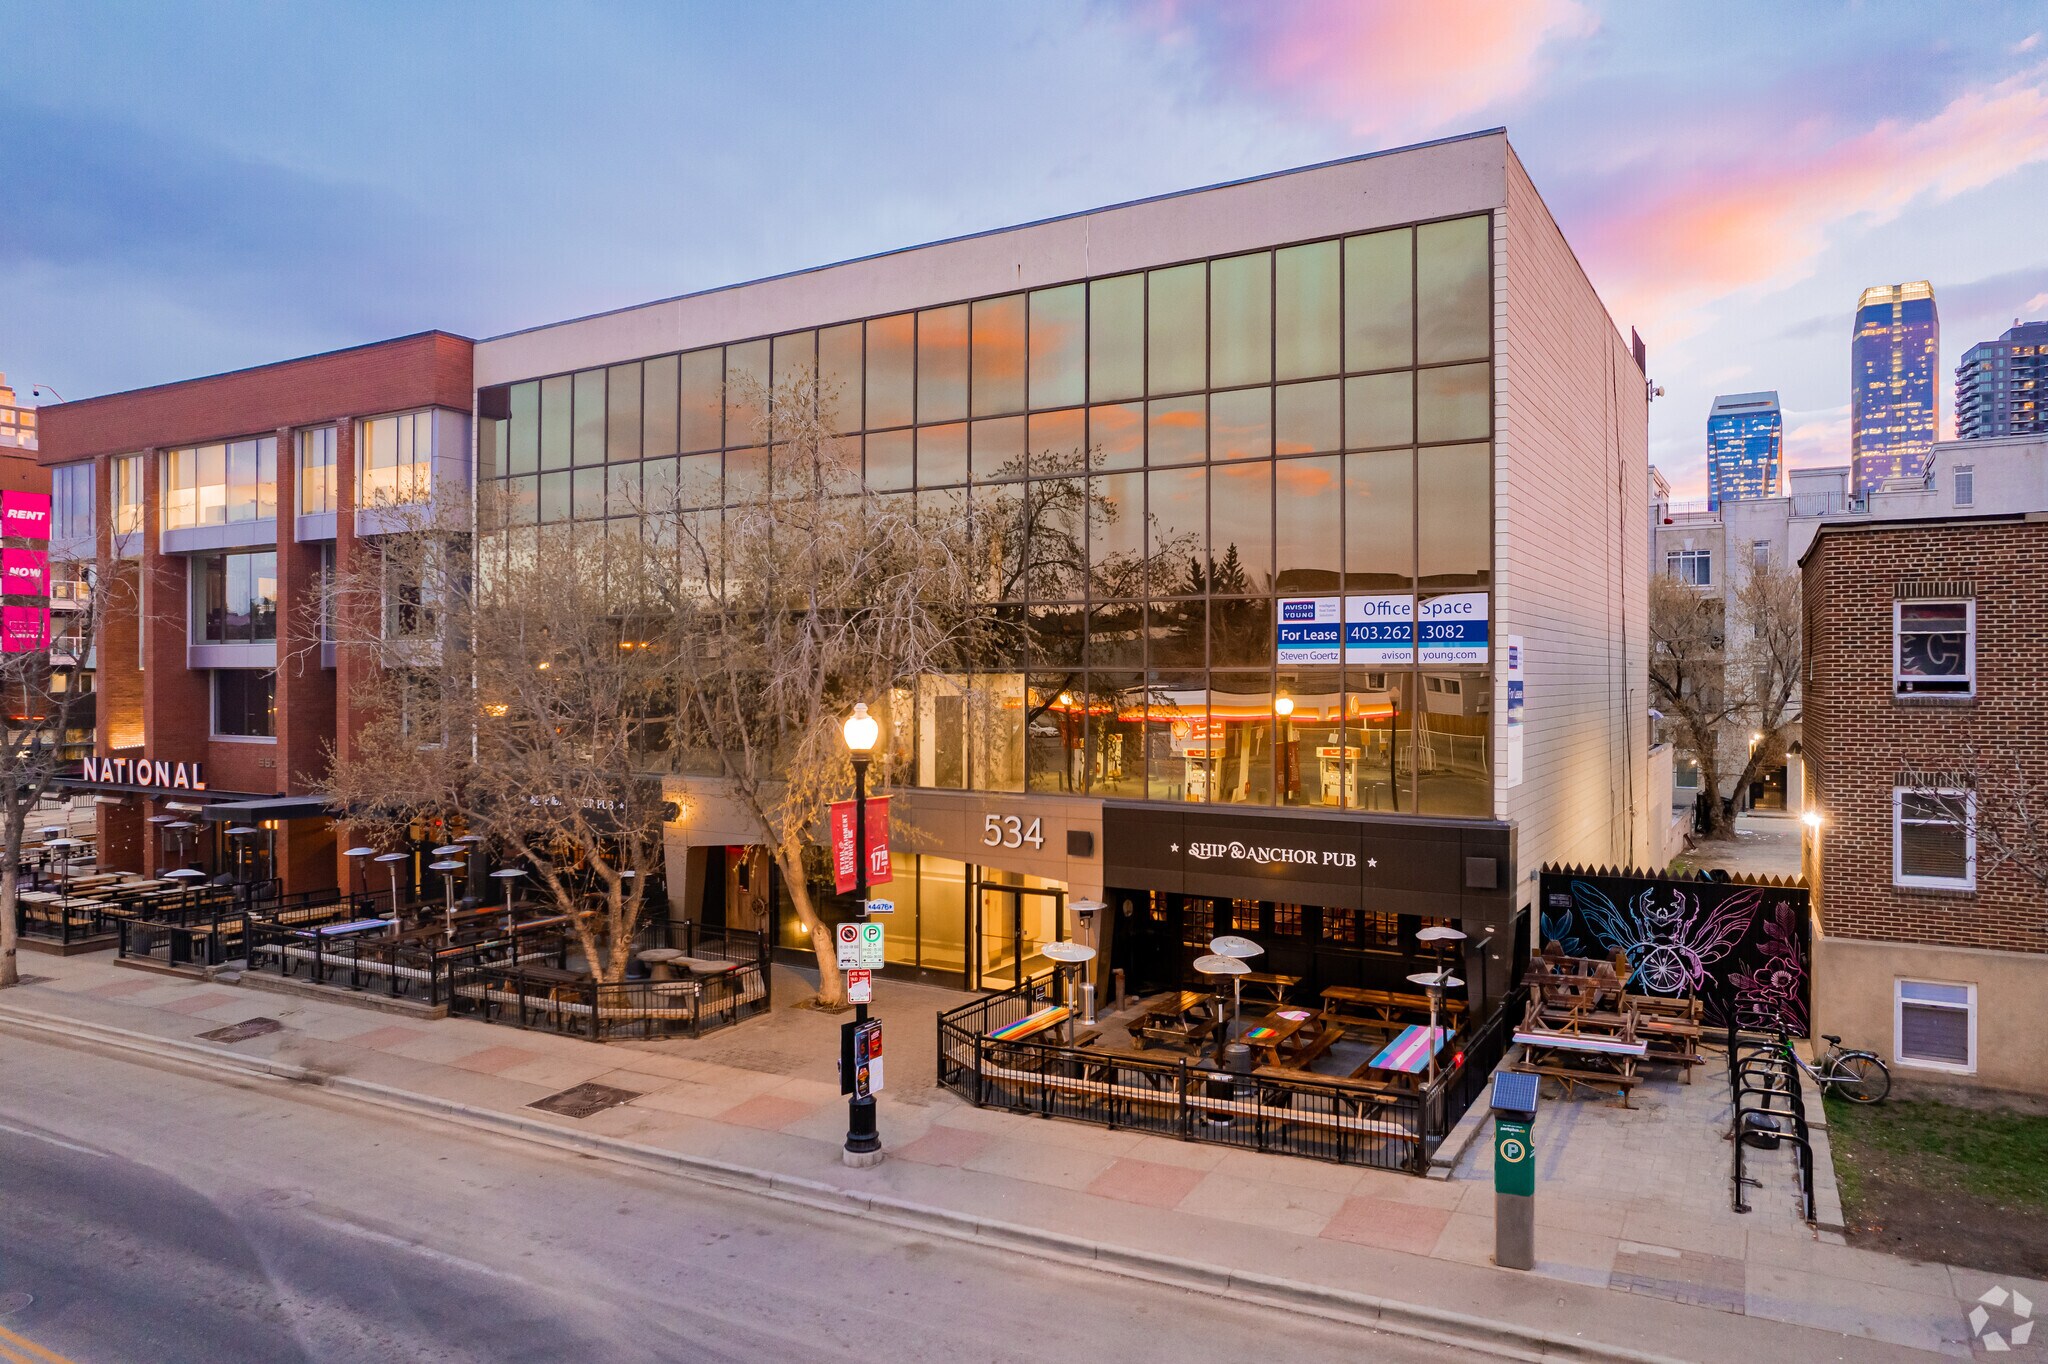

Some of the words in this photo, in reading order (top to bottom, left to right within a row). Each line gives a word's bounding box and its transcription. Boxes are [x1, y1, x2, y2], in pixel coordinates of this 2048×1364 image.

[7, 509, 45, 521] RENT
[9, 567, 41, 578] NOW
[1364, 601, 1411, 616] Office
[1422, 602, 1472, 618] Space
[1281, 630, 1301, 640] For
[1304, 629, 1338, 640] Lease
[1351, 626, 1411, 640] 403.262
[1280, 652, 1309, 660] Steven
[1309, 651, 1339, 660] Goertz
[1381, 651, 1412, 660] avison
[1422, 650, 1477, 661] young.com
[84, 757, 206, 790] NATIONAL
[983, 814, 1044, 850] 534
[870, 851, 882, 872] 17
[1188, 842, 1228, 860] SHIP
[1228, 841, 1246, 860] &
[1246, 847, 1319, 865] ANCHOR
[1322, 851, 1357, 868] PUB
[868, 928, 877, 939] P
[1508, 1143, 1518, 1157] P
